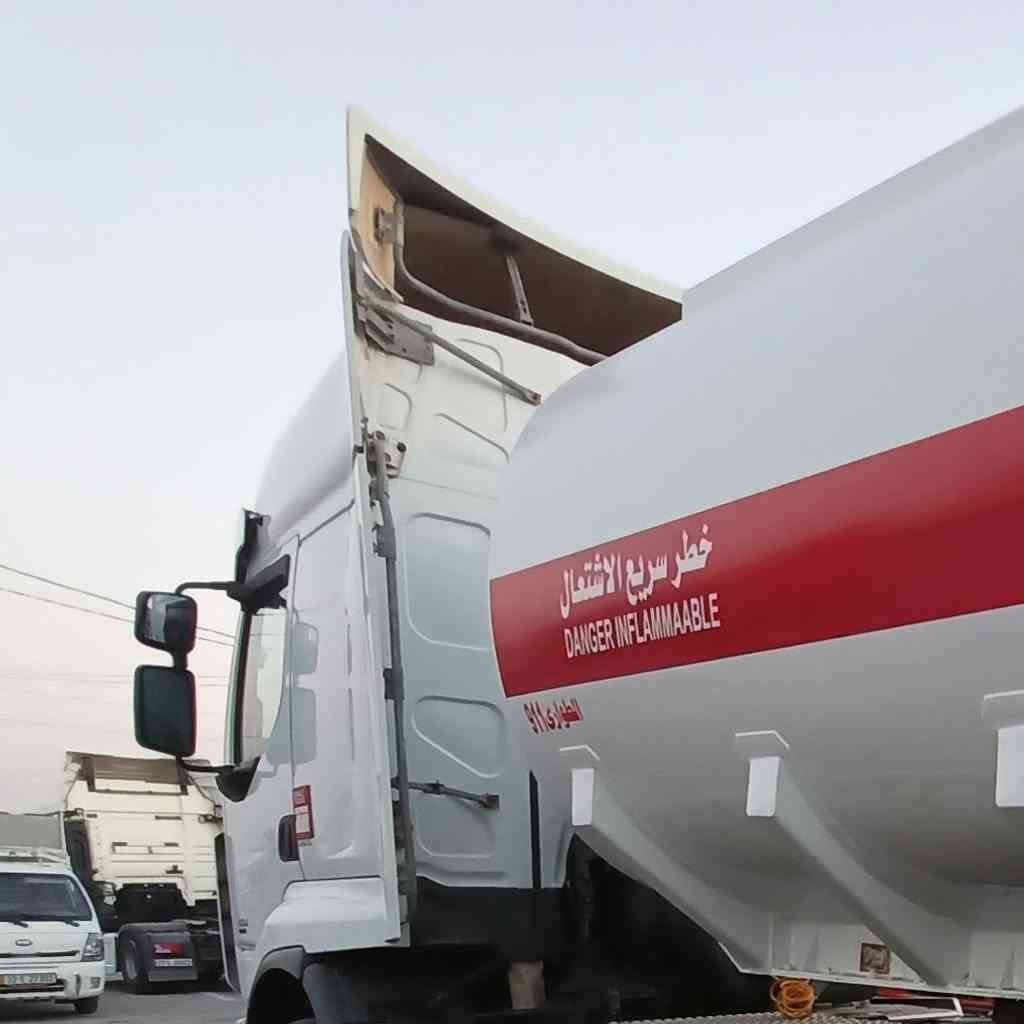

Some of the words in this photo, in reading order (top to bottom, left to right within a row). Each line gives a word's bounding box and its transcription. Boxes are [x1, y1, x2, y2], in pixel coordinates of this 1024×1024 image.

[559, 552, 622, 619] الاشتعال
[625, 551, 668, 606] سريع
[671, 523, 713, 589] خطر
[563, 617, 616, 659] DANGER
[614, 592, 721, 649] INFLAMMAABLE
